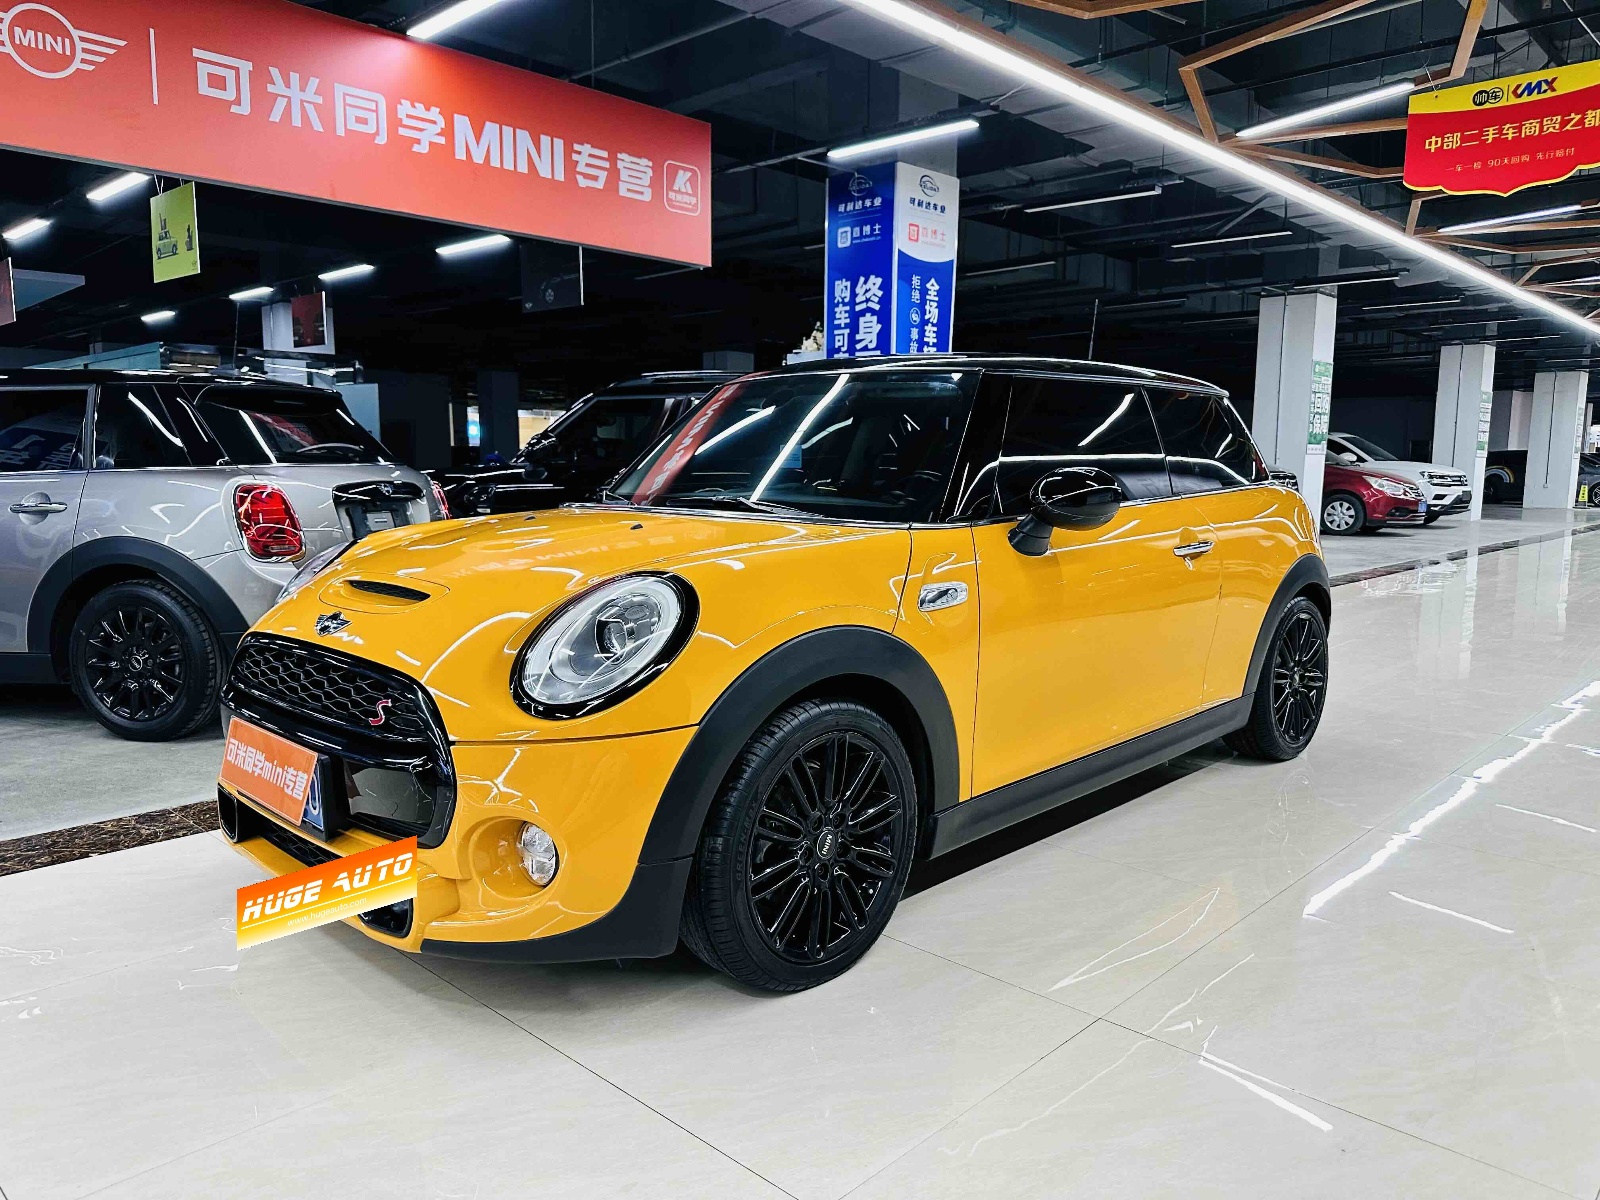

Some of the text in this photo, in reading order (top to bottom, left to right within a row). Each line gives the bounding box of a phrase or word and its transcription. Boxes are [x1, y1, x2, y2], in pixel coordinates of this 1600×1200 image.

[13, 26, 71, 56] MINI
[192, 47, 654, 202] 可米同学MINI专营
[1425, 108, 1600, 153] 中部二手车商贸之都
[1487, 154, 1530, 168] 90天回购
[369, 699, 392, 725] S
[821, 834, 833, 855] MINI
